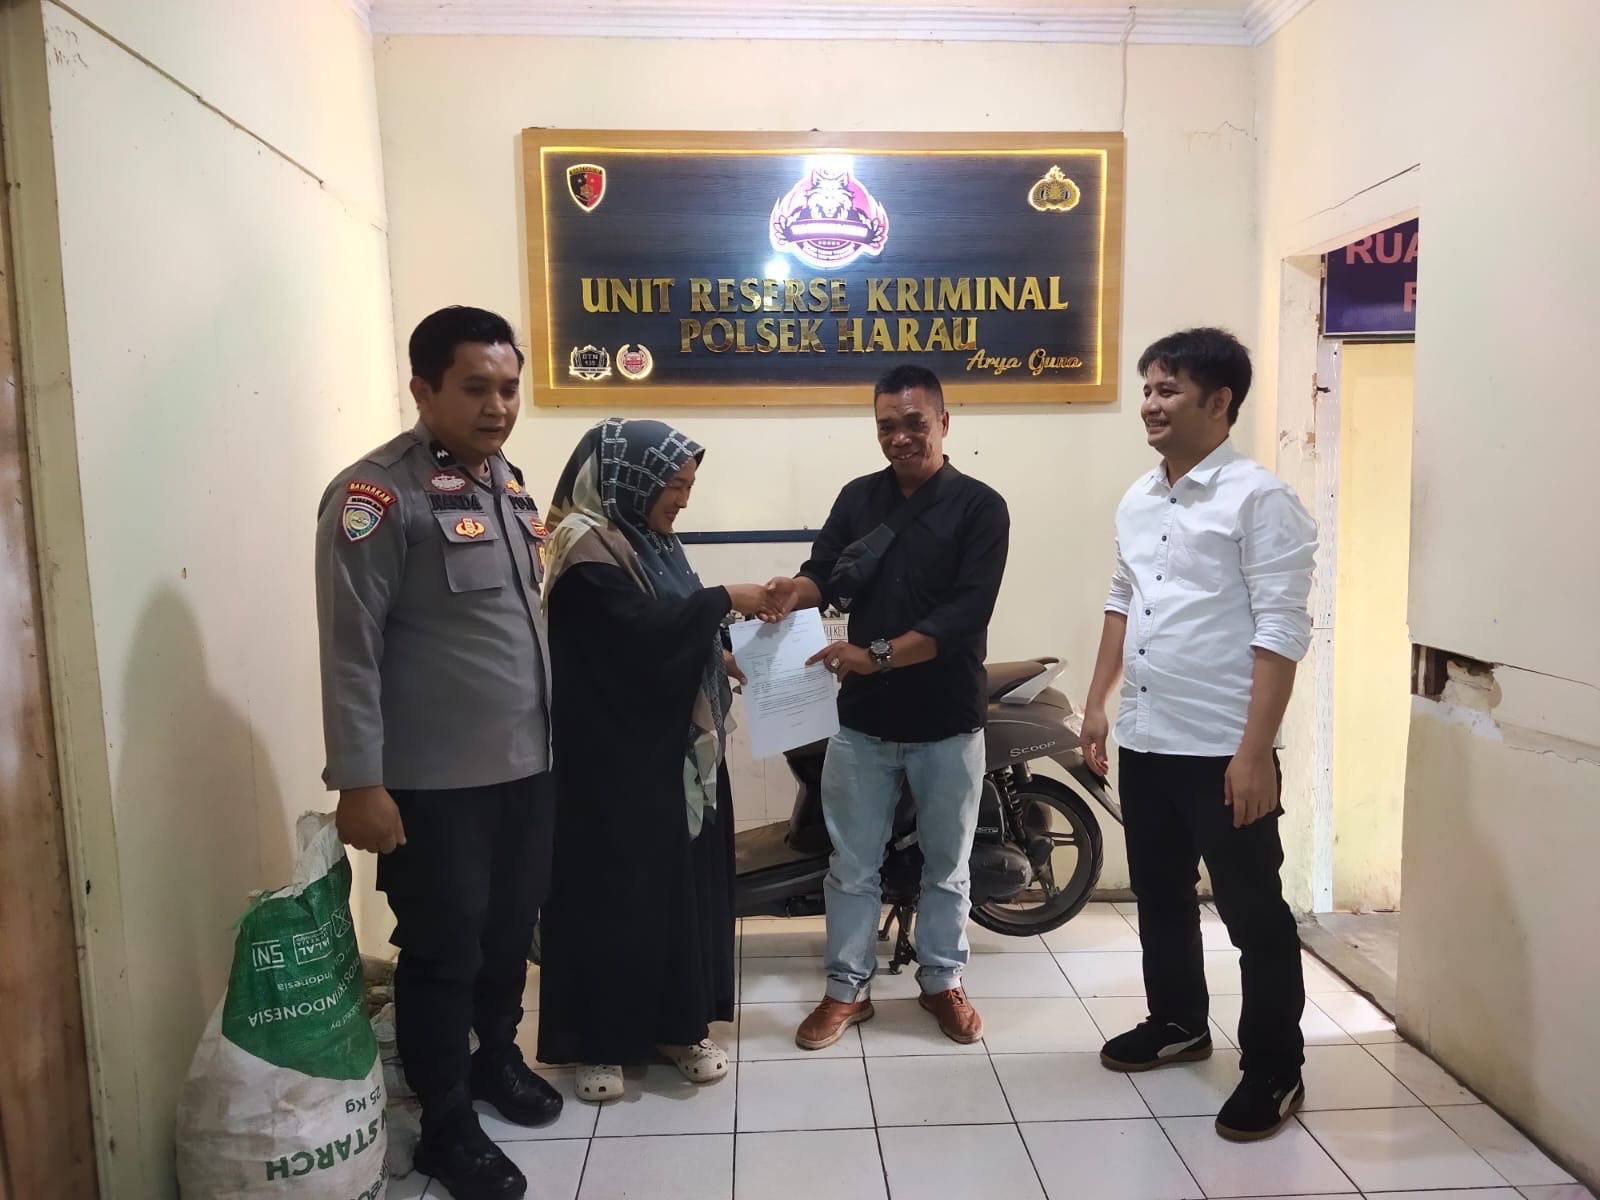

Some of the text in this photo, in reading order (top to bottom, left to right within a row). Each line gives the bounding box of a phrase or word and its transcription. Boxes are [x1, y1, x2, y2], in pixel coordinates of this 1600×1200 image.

[581, 276, 1069, 313] UNIT RESERSE KRIMINAL
[680, 317, 978, 353] POLSEK HARAU
[966, 347, 1083, 376] Arya Guna
[252, 943, 285, 968] SNI
[277, 971, 333, 992] Indonesia
[248, 992, 340, 1027] INDONESIA
[345, 1085, 382, 1114] 25 Kg
[265, 1118, 379, 1182] STARCH
